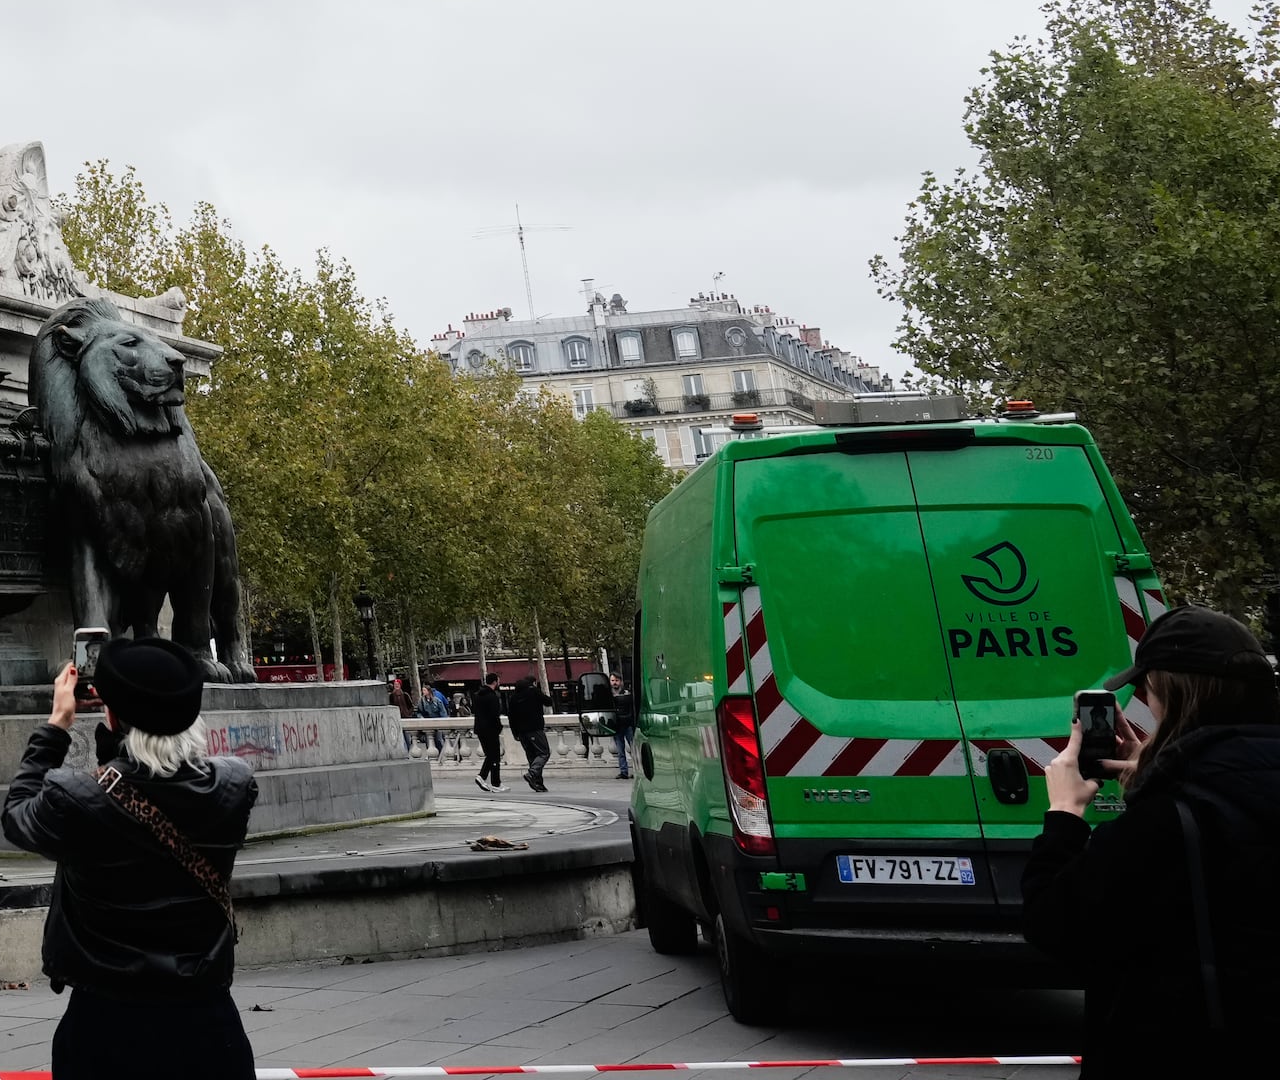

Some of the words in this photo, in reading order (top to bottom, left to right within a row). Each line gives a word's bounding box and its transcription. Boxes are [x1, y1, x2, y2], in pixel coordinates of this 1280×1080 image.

[1025, 448, 1053, 460] 320
[965, 612, 1018, 623] VILLE
[1029, 611, 1052, 621] DE
[948, 626, 1078, 658] PARIS
[803, 788, 871, 803] IVECO
[852, 859, 959, 881] FV-791-ZZ
[961, 872, 973, 882] 92
